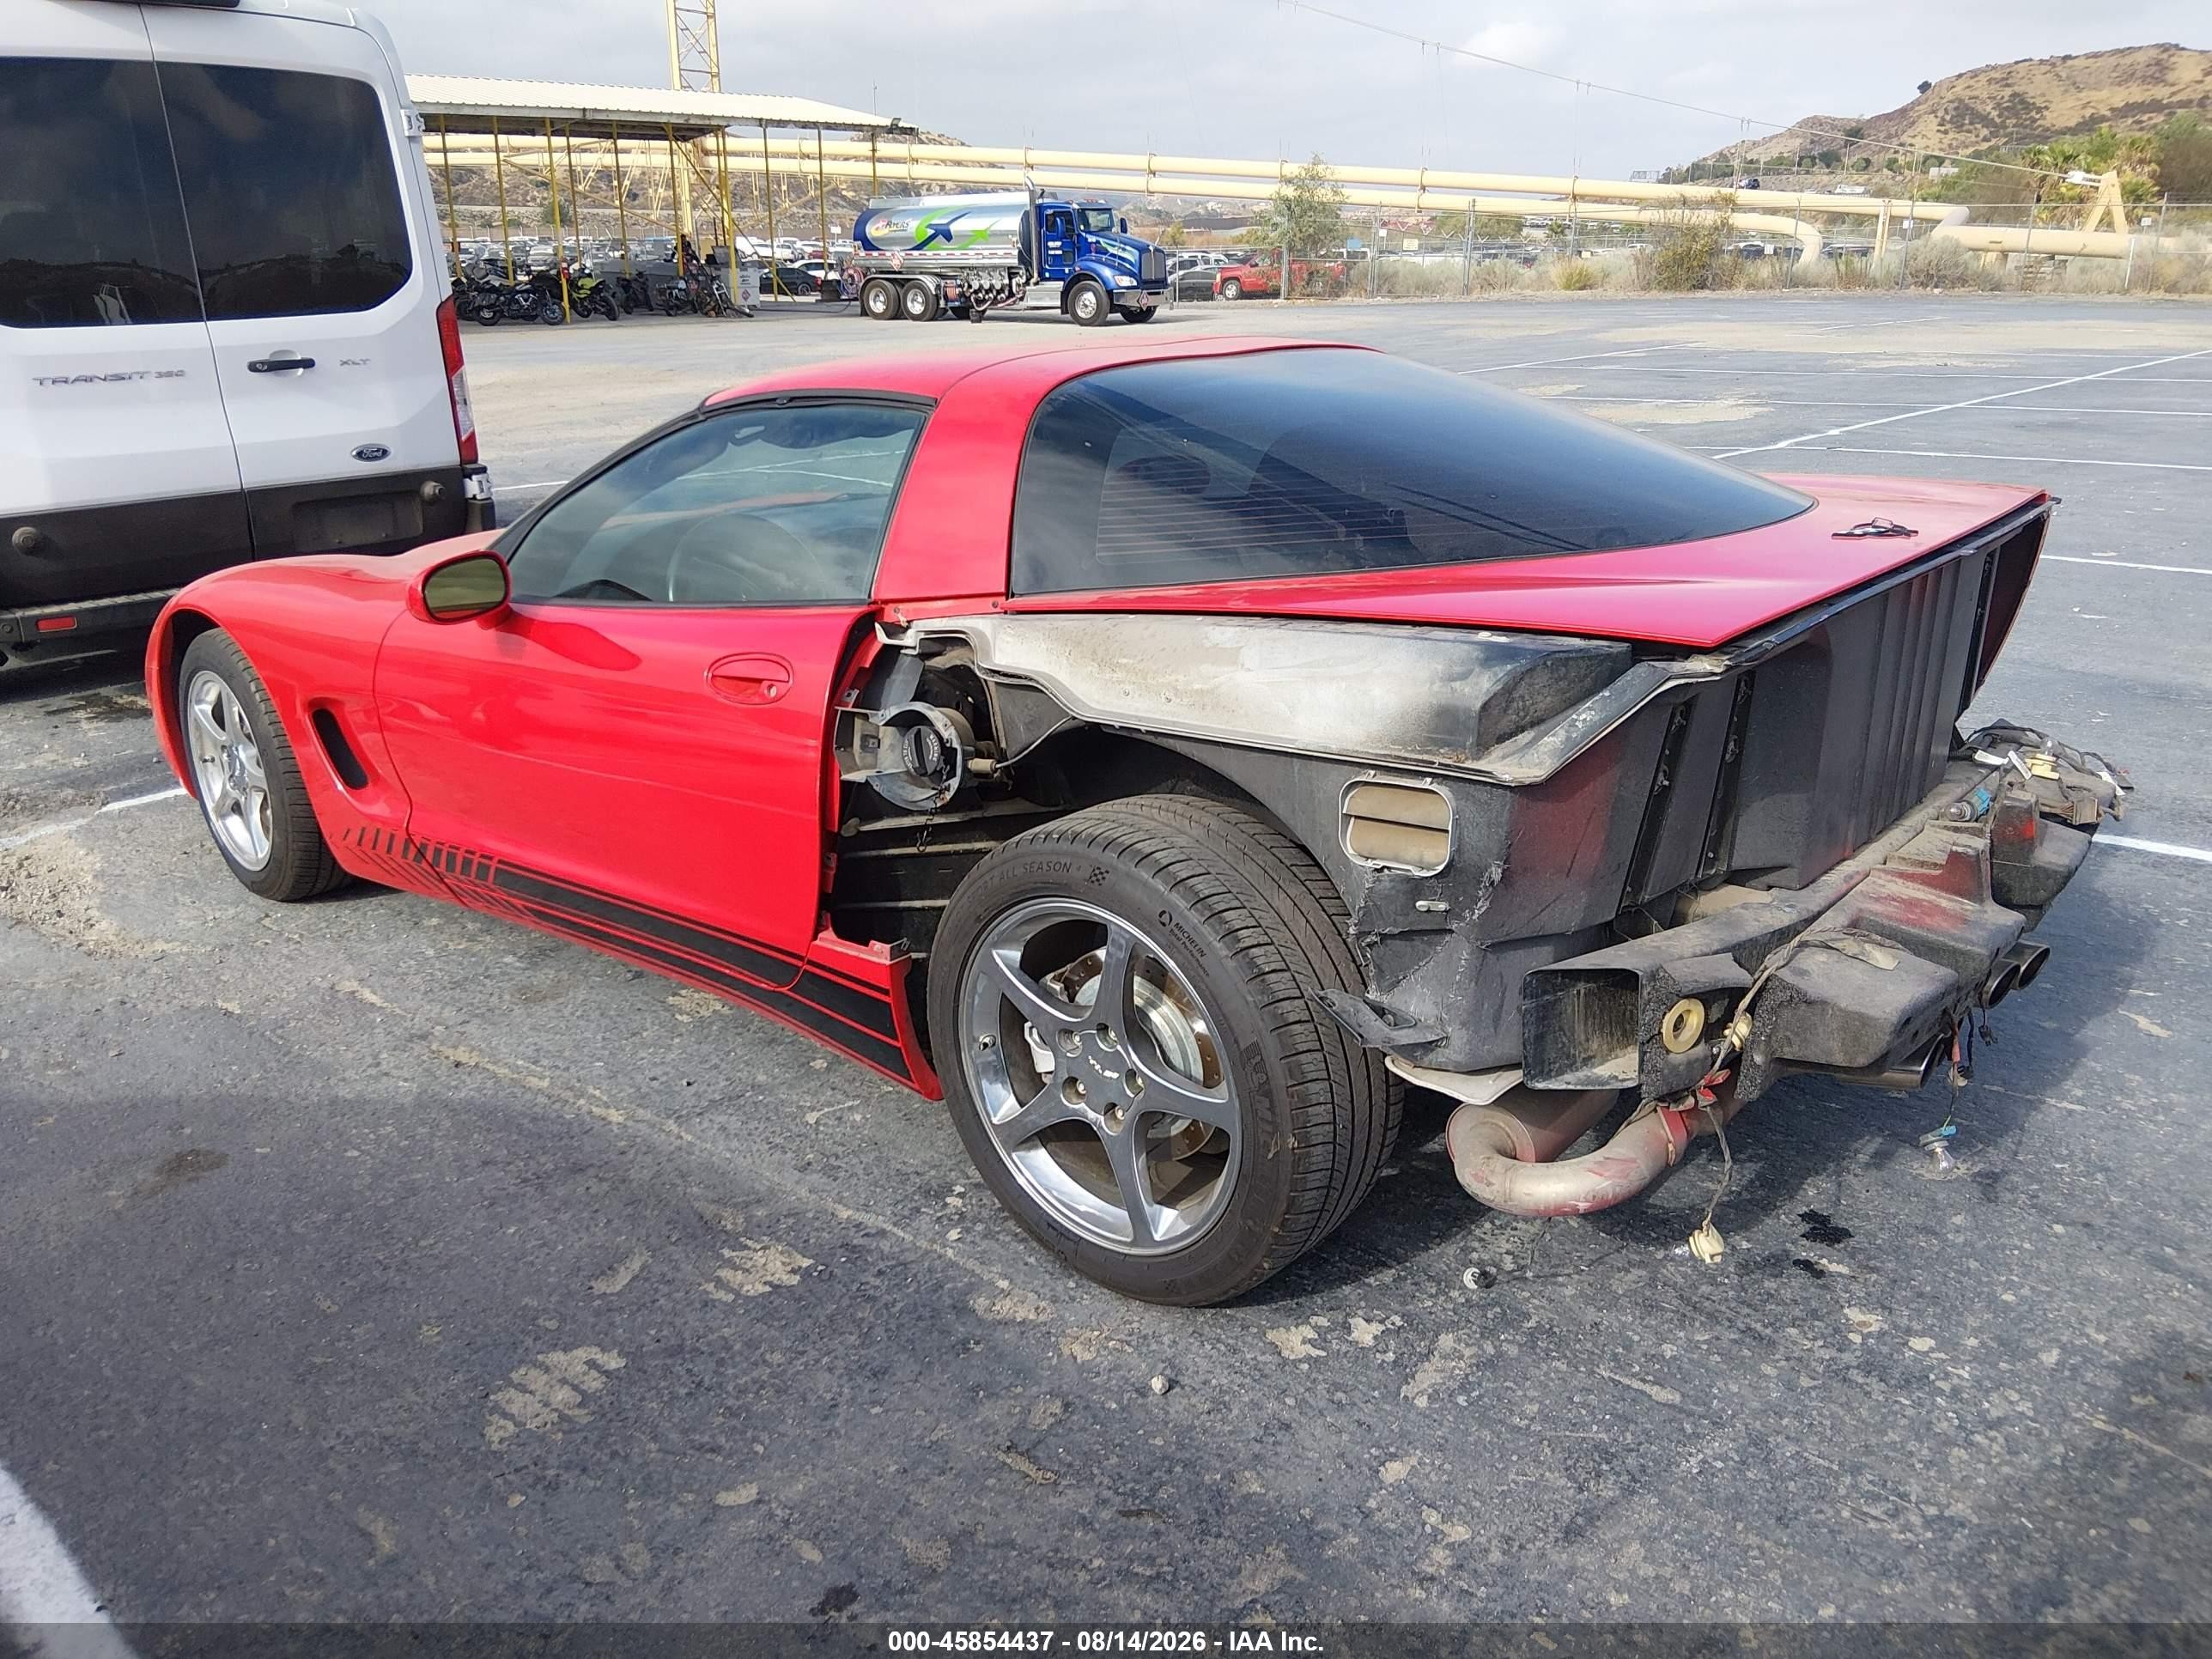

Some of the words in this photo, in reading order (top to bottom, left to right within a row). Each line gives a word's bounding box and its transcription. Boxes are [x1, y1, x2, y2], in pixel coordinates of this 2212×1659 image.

[339, 358, 371, 367] XLT
[33, 370, 152, 386] TRANSIT
[1022, 860, 1073, 874] SEASON
[1173, 921, 1207, 958] MICHELIN
[1169, 928, 1183, 942] Total
[1181, 940, 1210, 978] Performance
